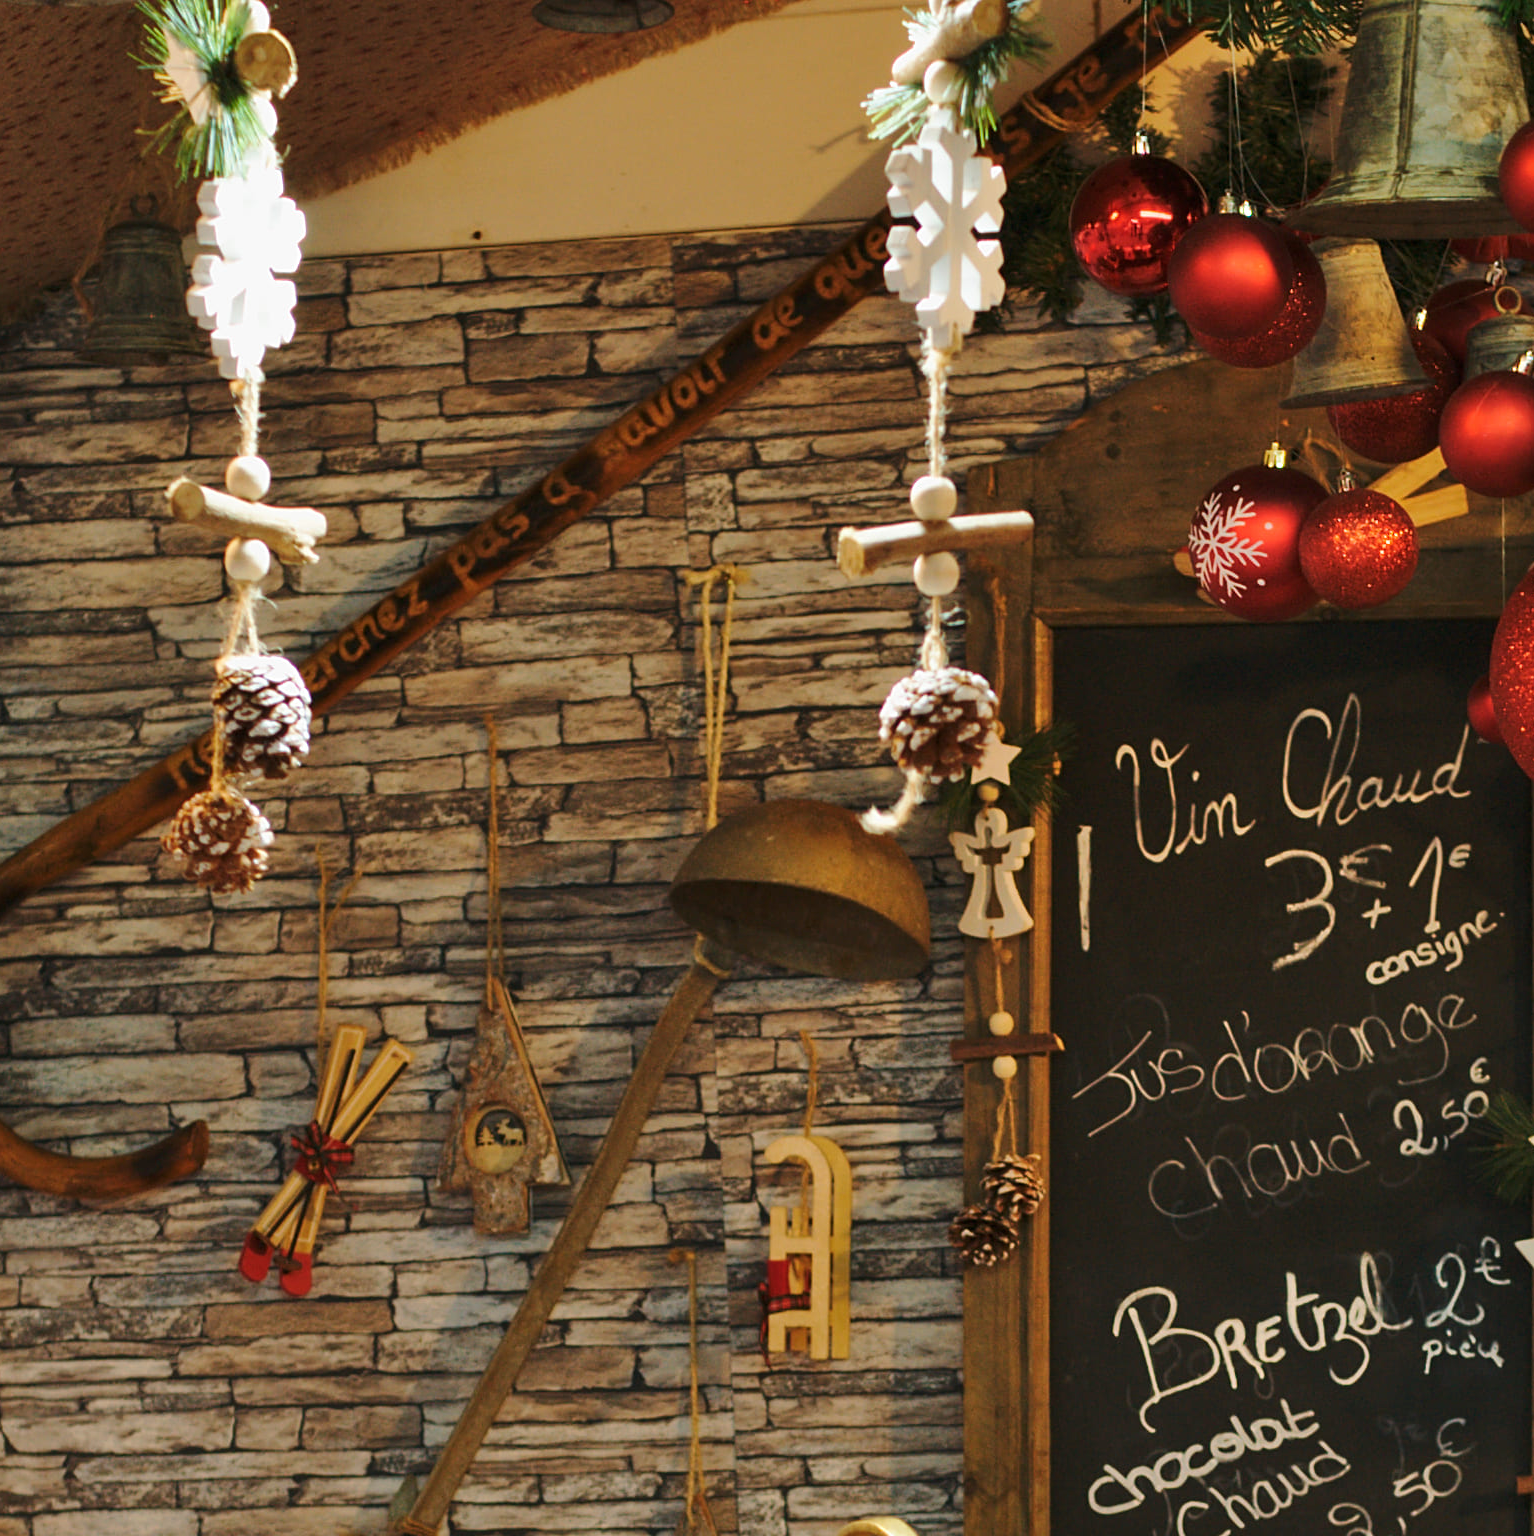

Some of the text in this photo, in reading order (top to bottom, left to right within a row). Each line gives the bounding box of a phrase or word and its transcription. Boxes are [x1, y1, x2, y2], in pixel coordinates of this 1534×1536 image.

[447, 512, 530, 588] pas
[1116, 693, 1471, 863] Vin Chaud
